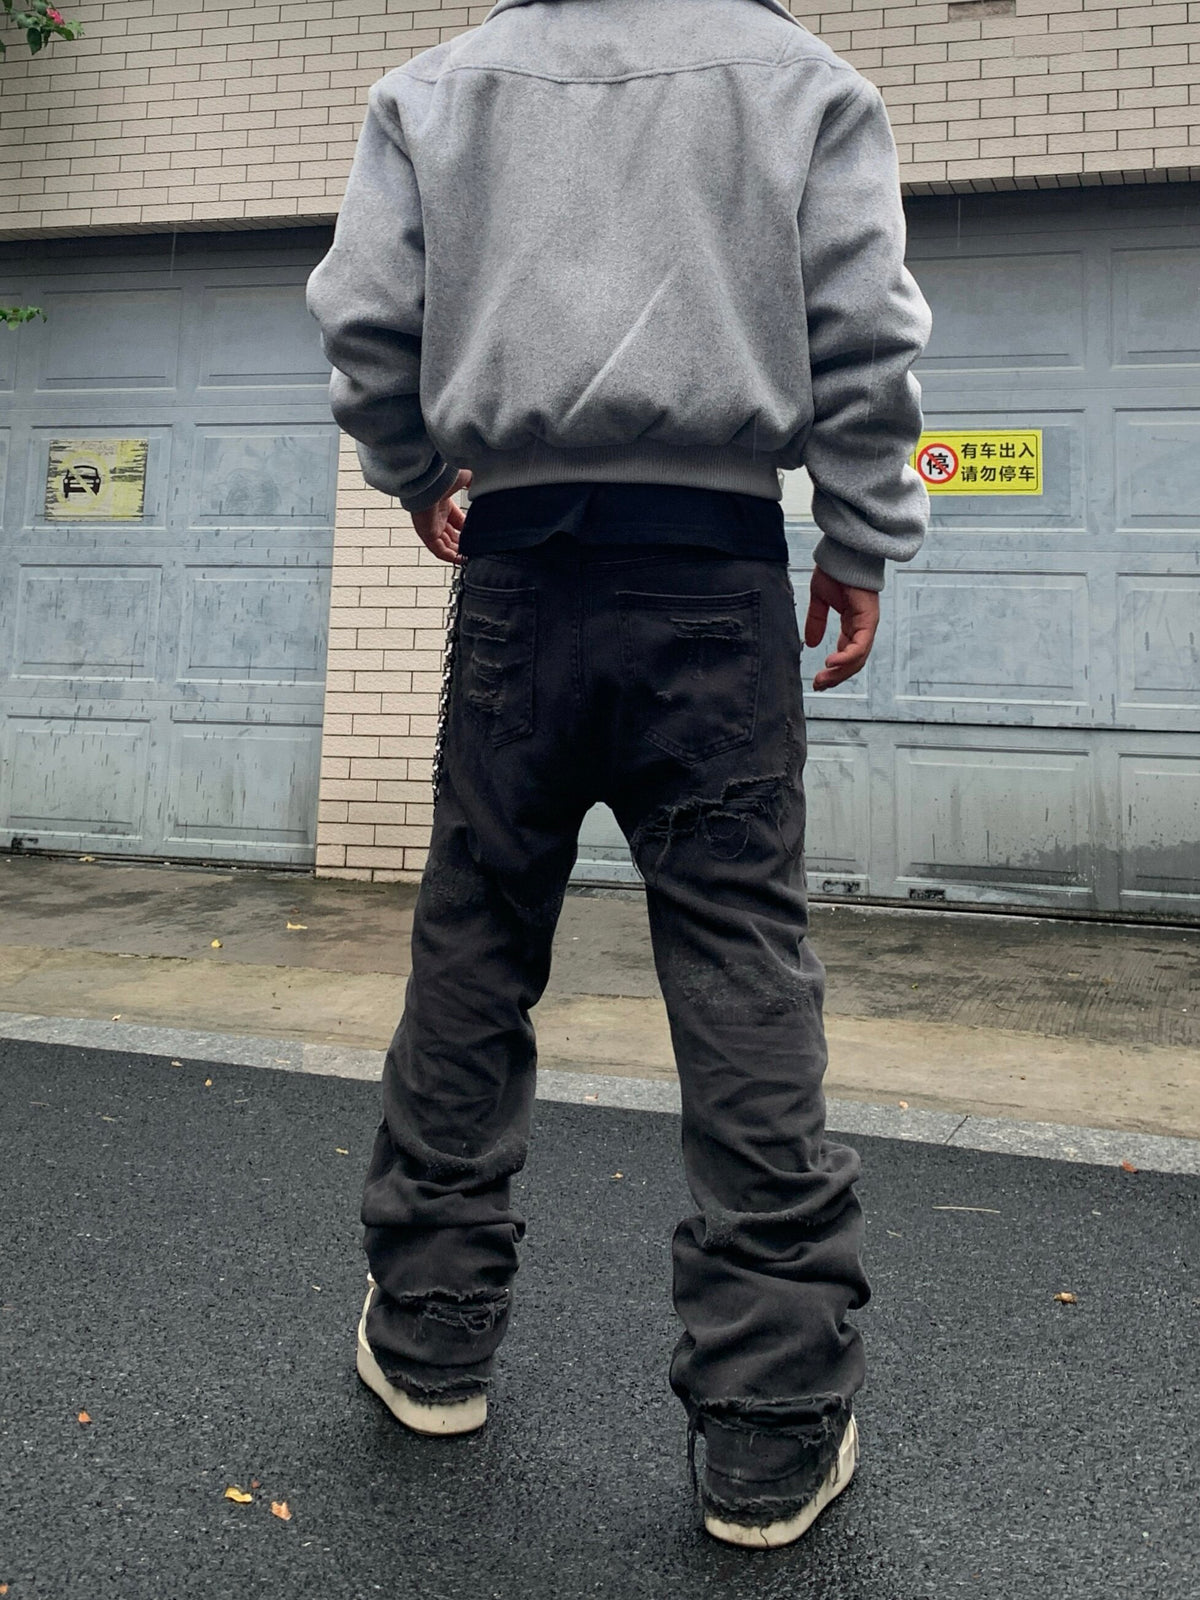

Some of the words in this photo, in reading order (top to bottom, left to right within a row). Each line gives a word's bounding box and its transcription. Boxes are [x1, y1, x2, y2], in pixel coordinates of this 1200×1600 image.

[961, 442, 1035, 459] 有车出入
[926, 452, 949, 475] 停
[961, 465, 1035, 482] 请勿停车
